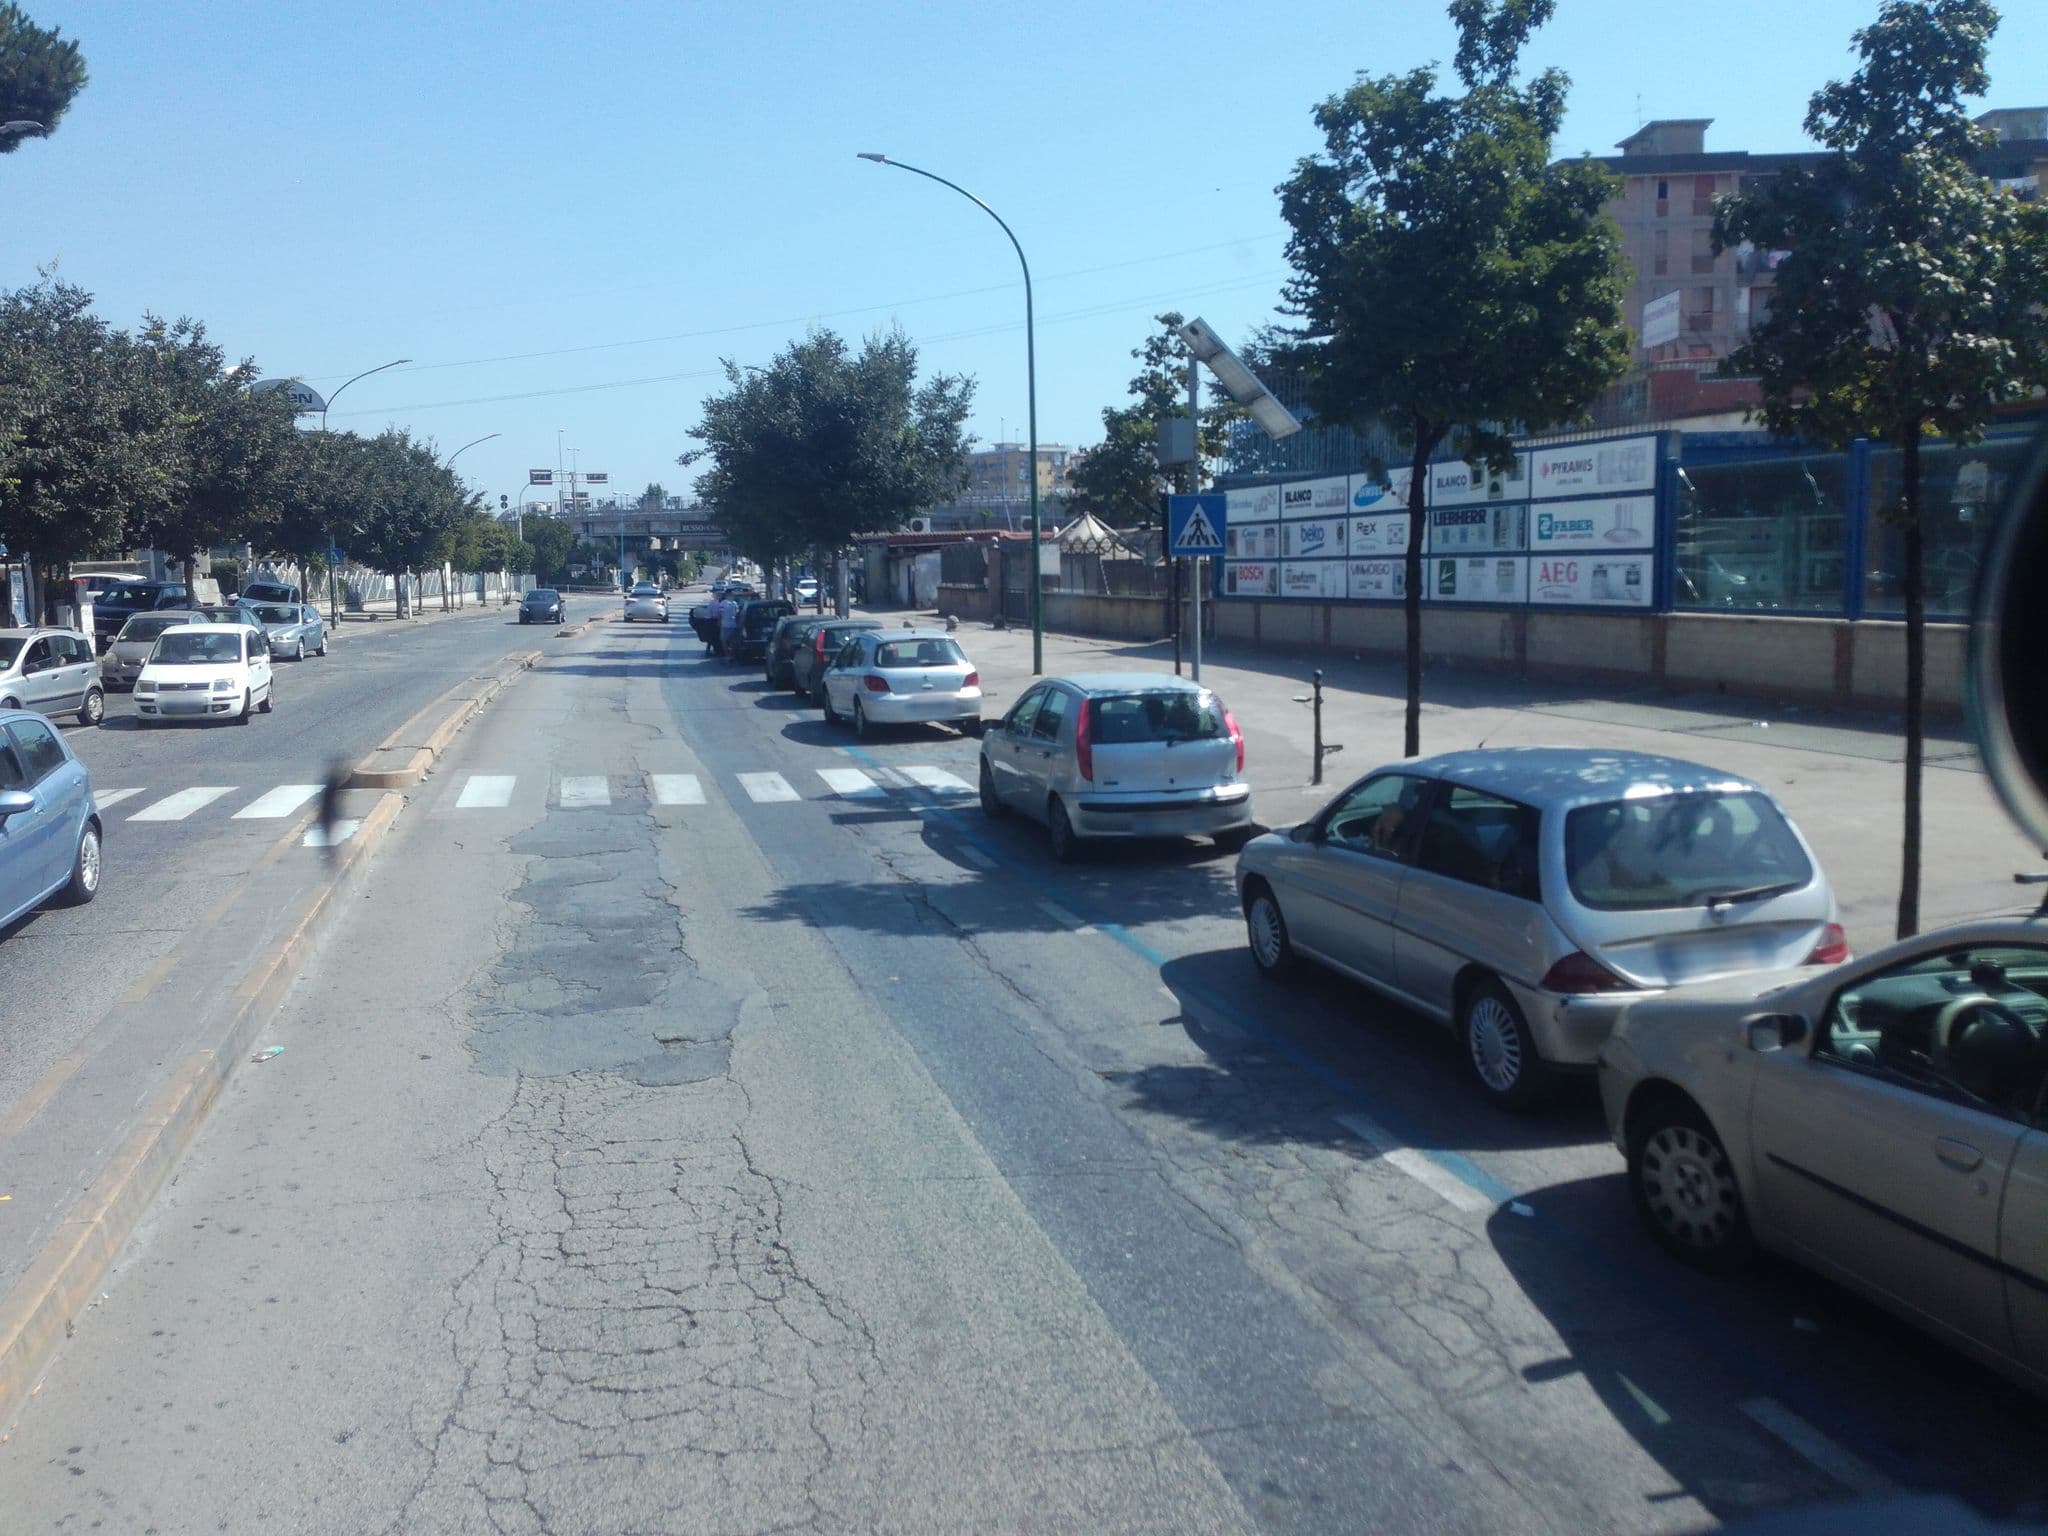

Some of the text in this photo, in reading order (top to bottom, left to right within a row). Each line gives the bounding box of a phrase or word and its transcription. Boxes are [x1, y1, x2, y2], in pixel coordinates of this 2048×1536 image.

[1551, 458, 1593, 475] PYRAMIS
[1436, 475, 1468, 489] BLANCO
[1284, 489, 1313, 504] BLANCO
[1433, 509, 1487, 526] LIEBHERR
[1554, 519, 1594, 532] FABER
[1300, 523, 1325, 542] beko
[1239, 565, 1265, 581] BOSCH
[1539, 561, 1579, 583] AEG
